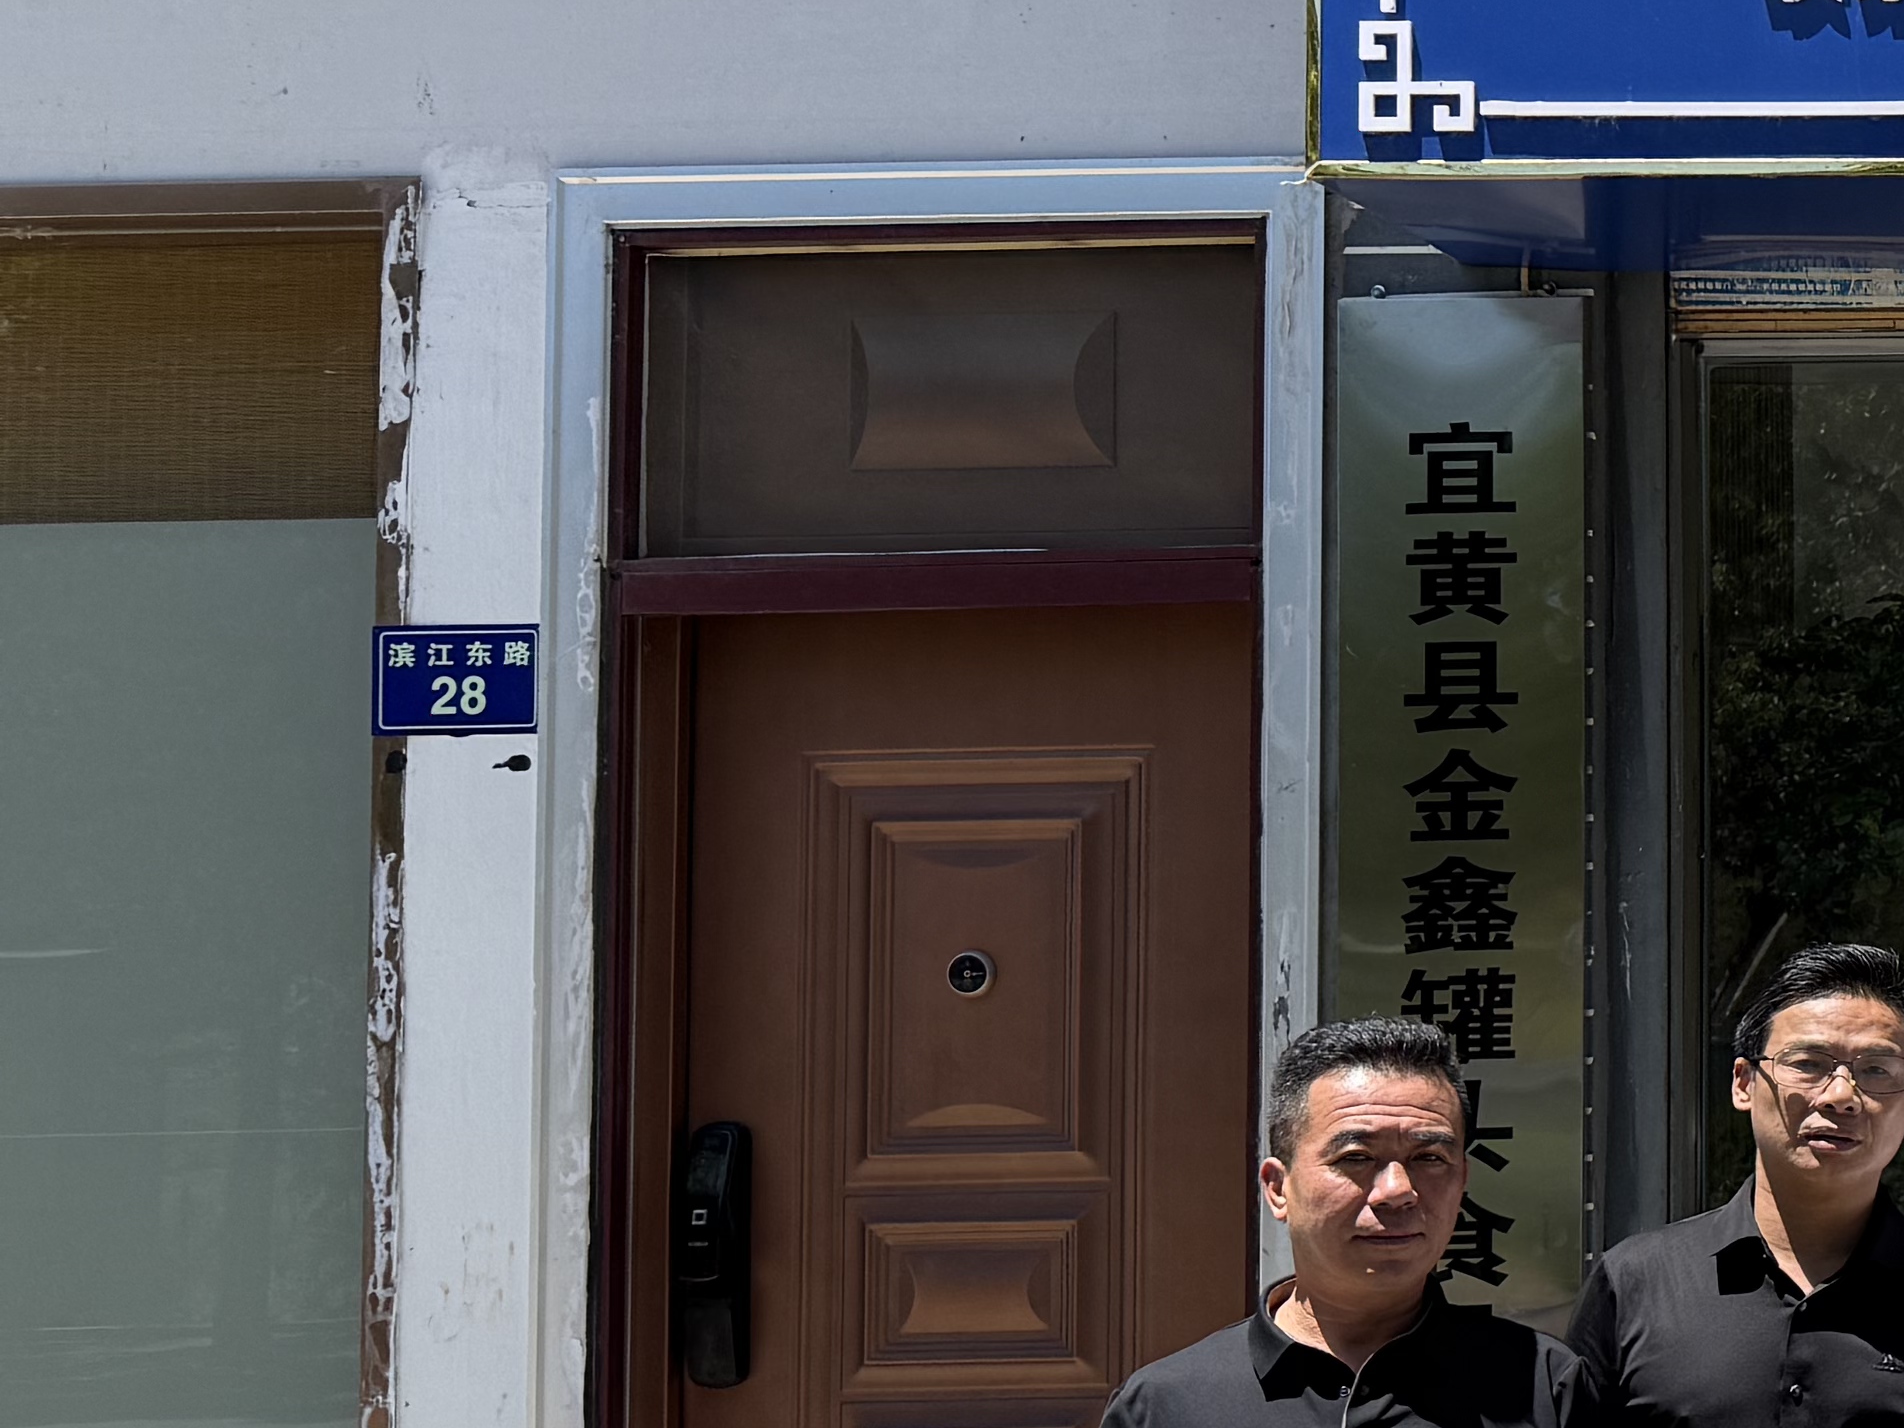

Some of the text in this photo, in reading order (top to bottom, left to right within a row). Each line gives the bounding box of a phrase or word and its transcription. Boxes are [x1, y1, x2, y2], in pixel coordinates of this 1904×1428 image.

[388, 641, 531, 668] 滨江东路
[430, 675, 487, 715] 28
